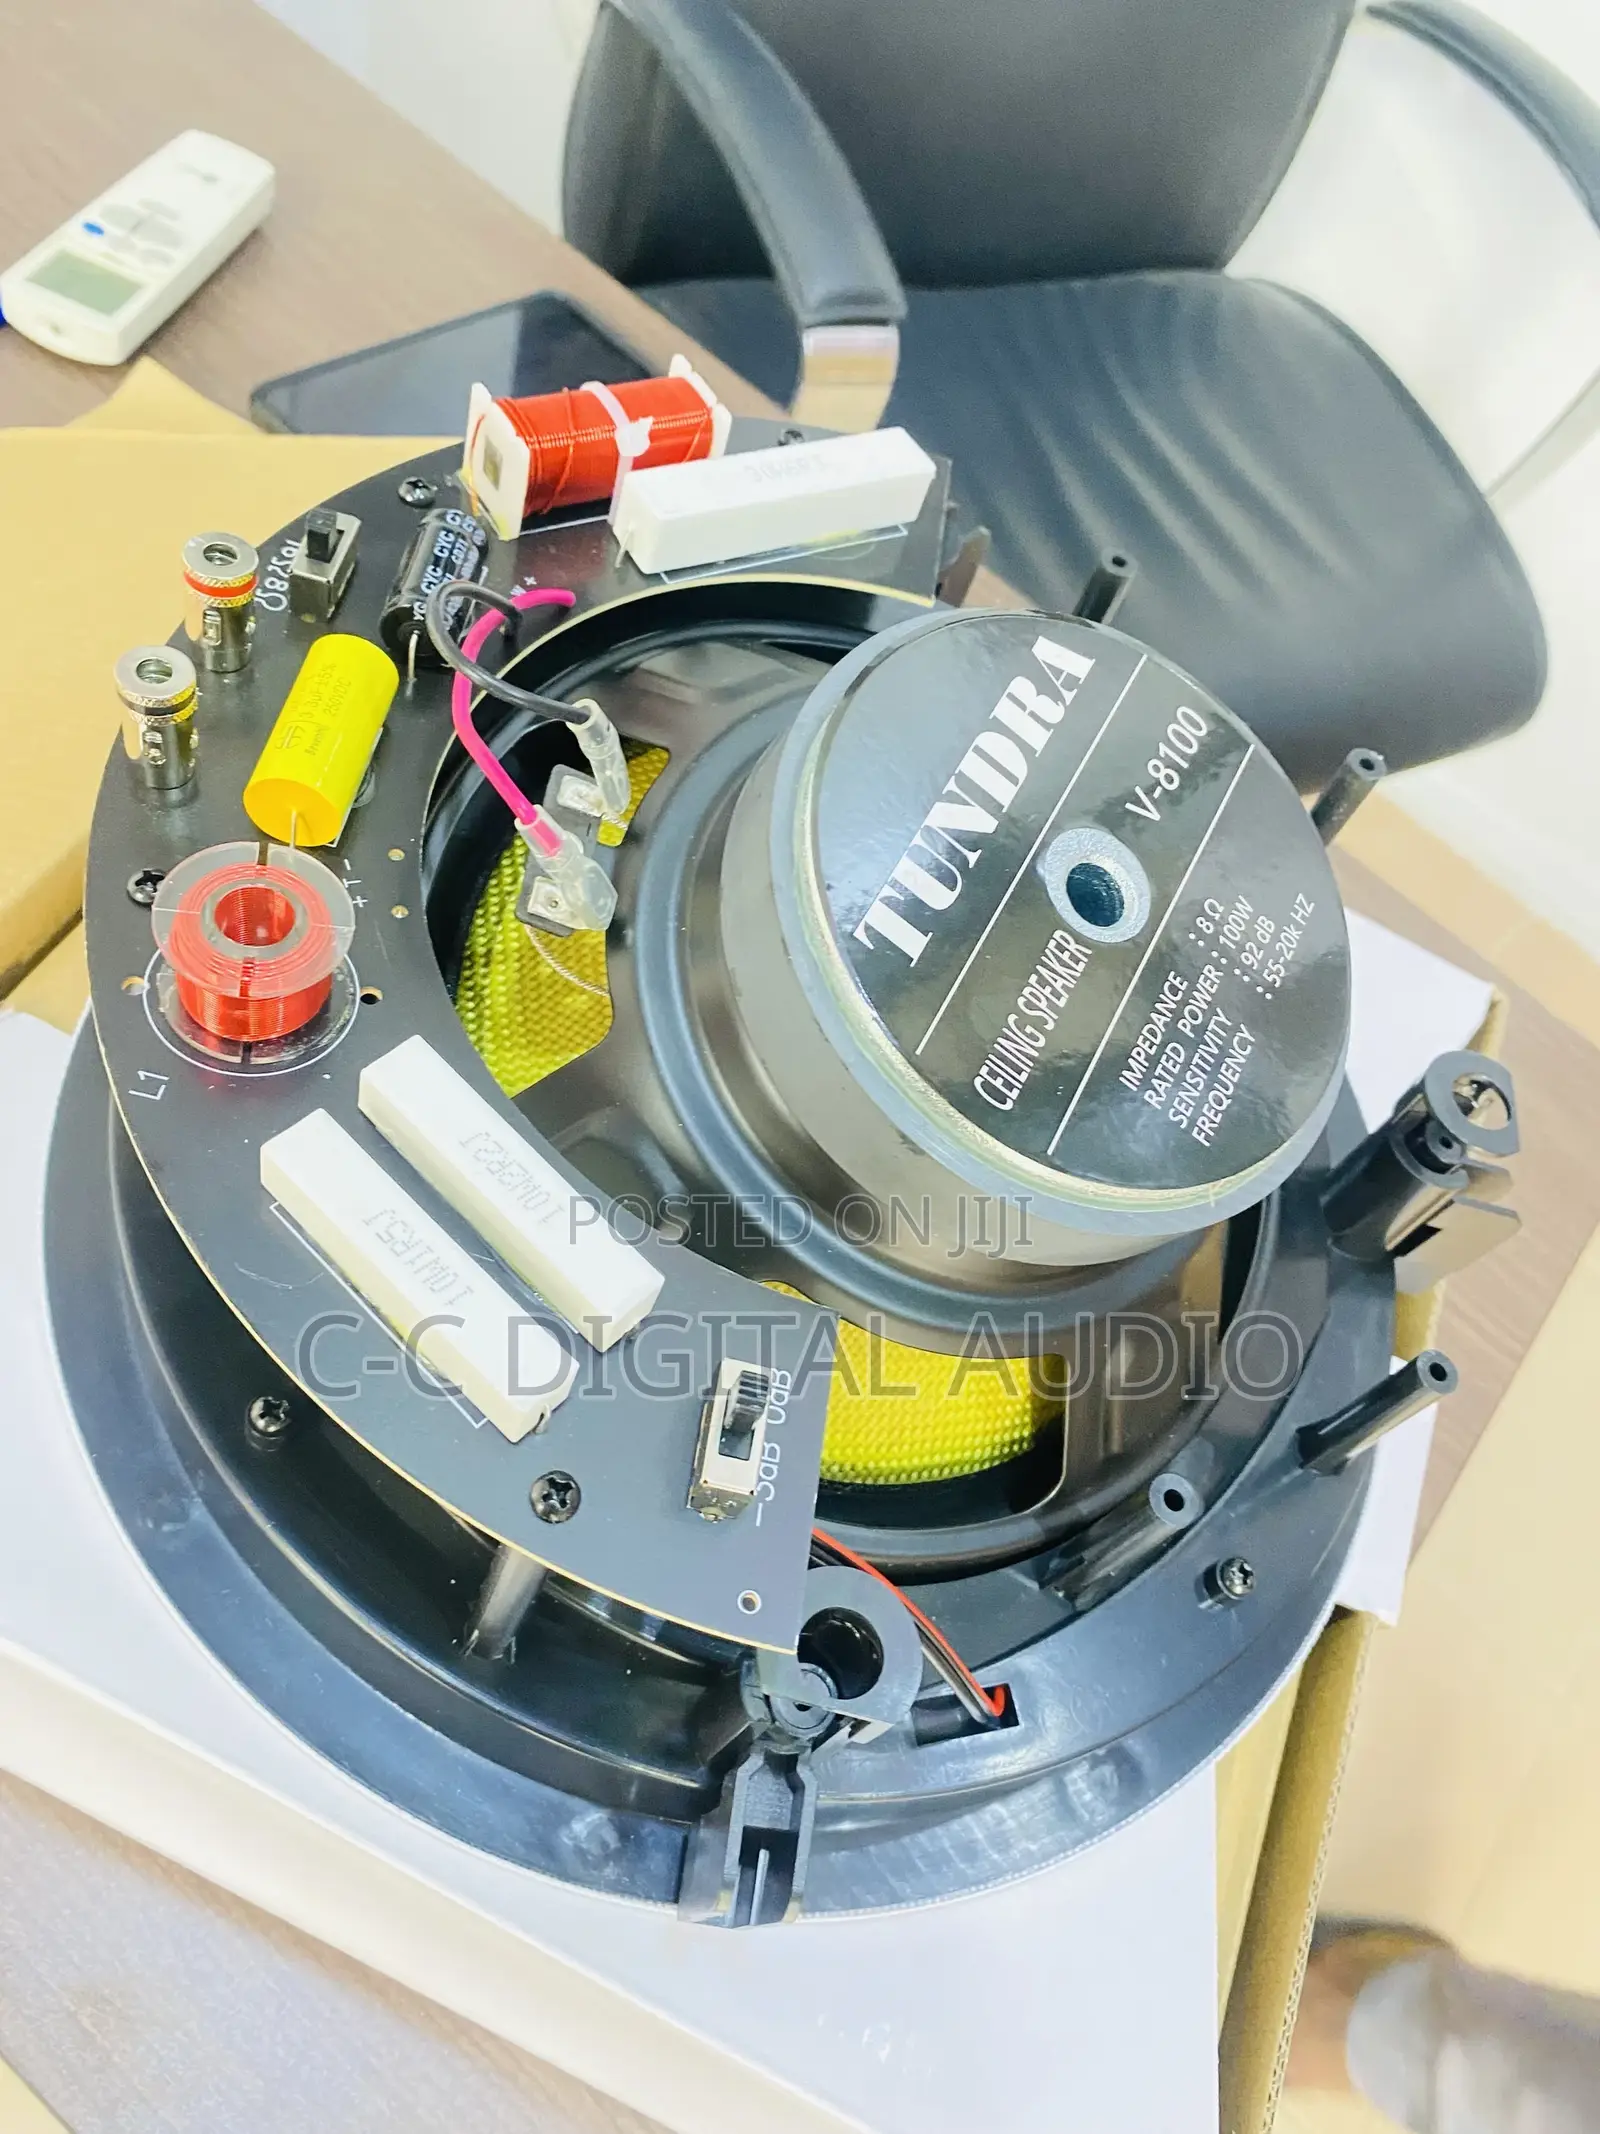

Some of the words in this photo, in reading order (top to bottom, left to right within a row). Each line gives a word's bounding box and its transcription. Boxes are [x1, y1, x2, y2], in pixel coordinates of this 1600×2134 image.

[433, 530, 456, 558] CYC
[853, 635, 1096, 968] TUNDRA
[1125, 705, 1209, 823] V-8100
[127, 1069, 170, 1101] L1
[974, 1013, 1046, 1111] CEILING
[1016, 929, 1093, 1031] SPEAKER
[1119, 970, 1189, 1092] IMPEDANCE
[1144, 1041, 1186, 1111] RATED
[1177, 963, 1225, 1039] POWER
[1218, 894, 1255, 950] 100W
[1169, 1007, 1233, 1130] SENSITIVITY
[1240, 941, 1264, 970] 92
[1254, 914, 1276, 945] dB
[1191, 1023, 1256, 1148] FREQUENCY
[1262, 923, 1304, 989] 55-20k
[1290, 892, 1316, 926] HZ
